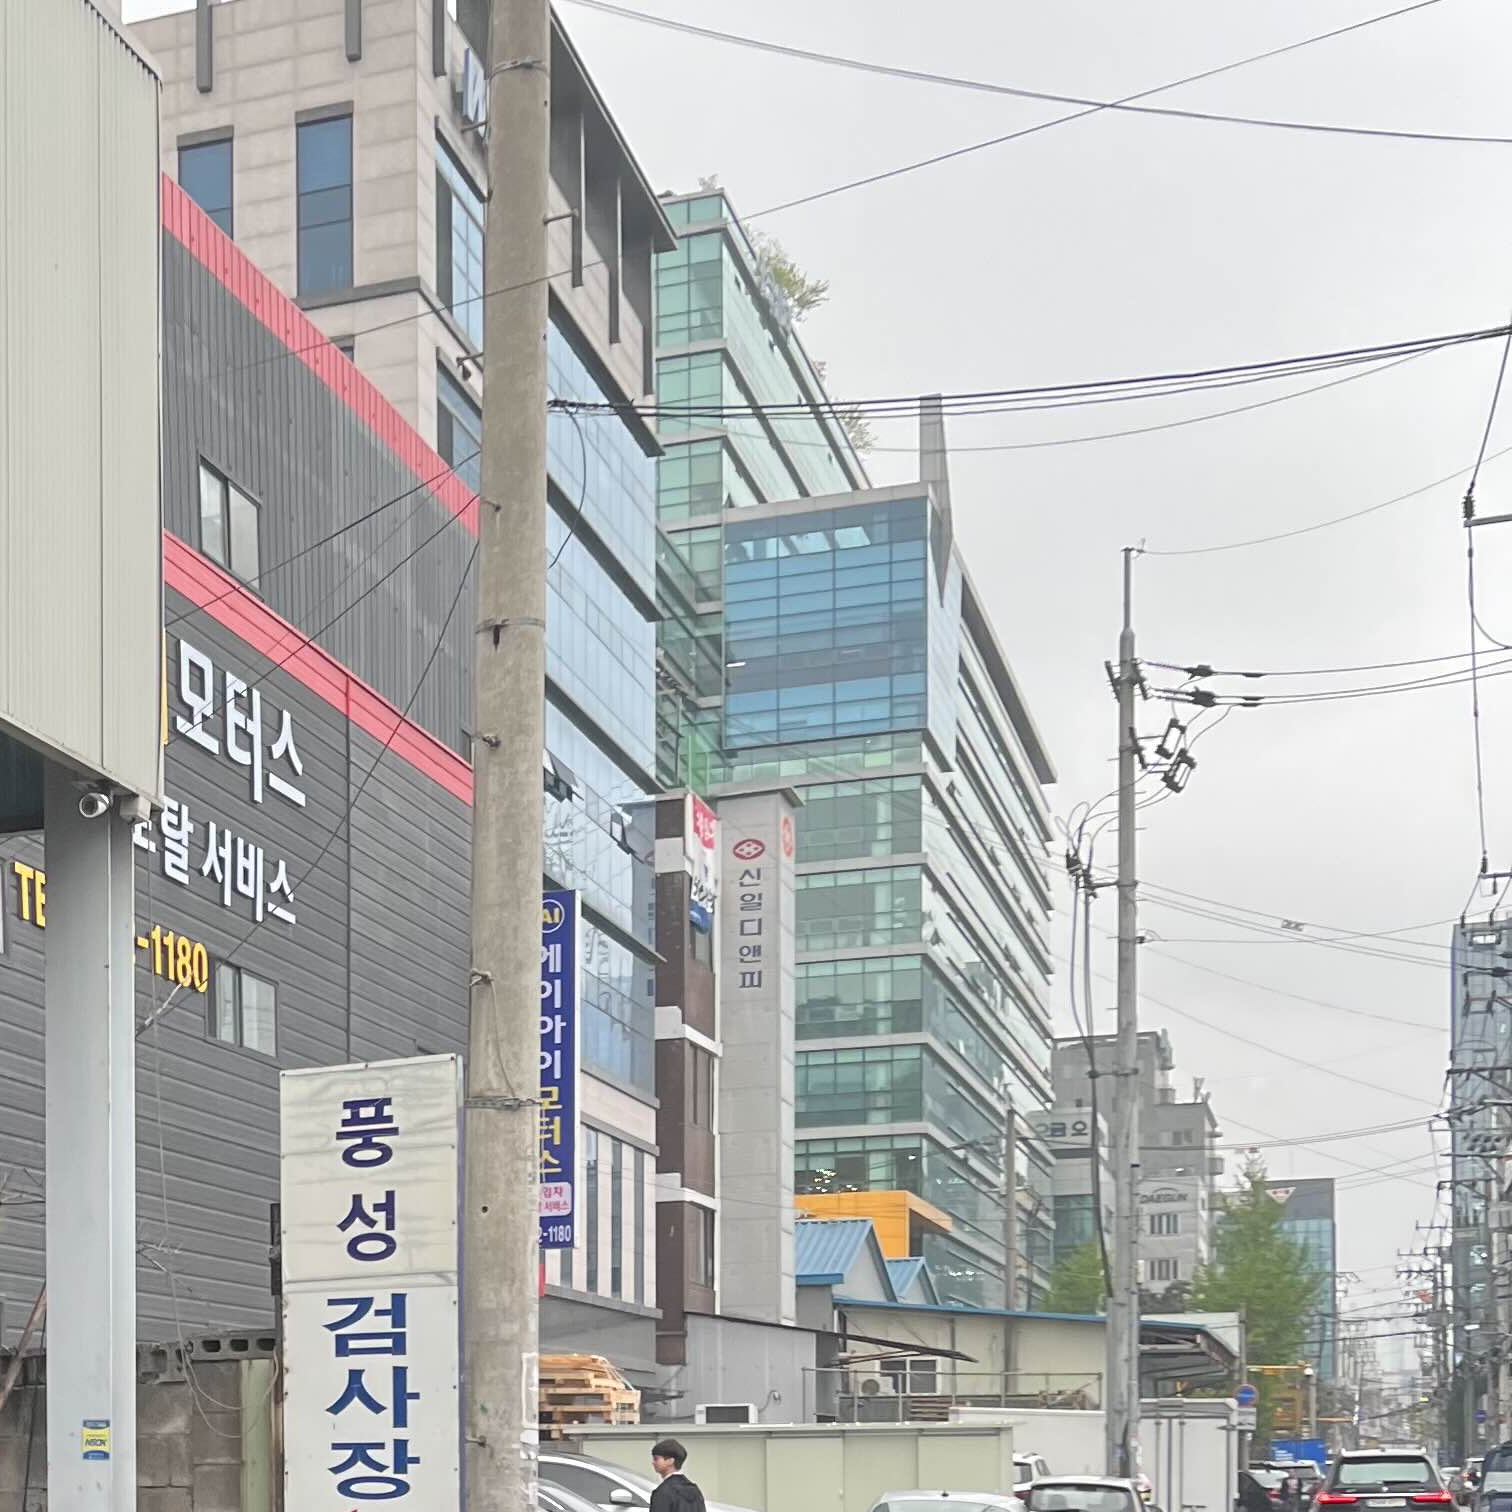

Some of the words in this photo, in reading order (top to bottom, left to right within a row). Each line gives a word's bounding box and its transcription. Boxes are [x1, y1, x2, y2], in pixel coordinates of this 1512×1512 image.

[176, 639, 306, 807] 모터스
[14, 861, 46, 927] TE
[134, 924, 209, 993] -1180
[201, 820, 296, 925] 서비스
[739, 868, 763, 989] 신일디앤피
[336, 1097, 399, 1262] 풍성
[322, 1293, 420, 1501] 검사장
